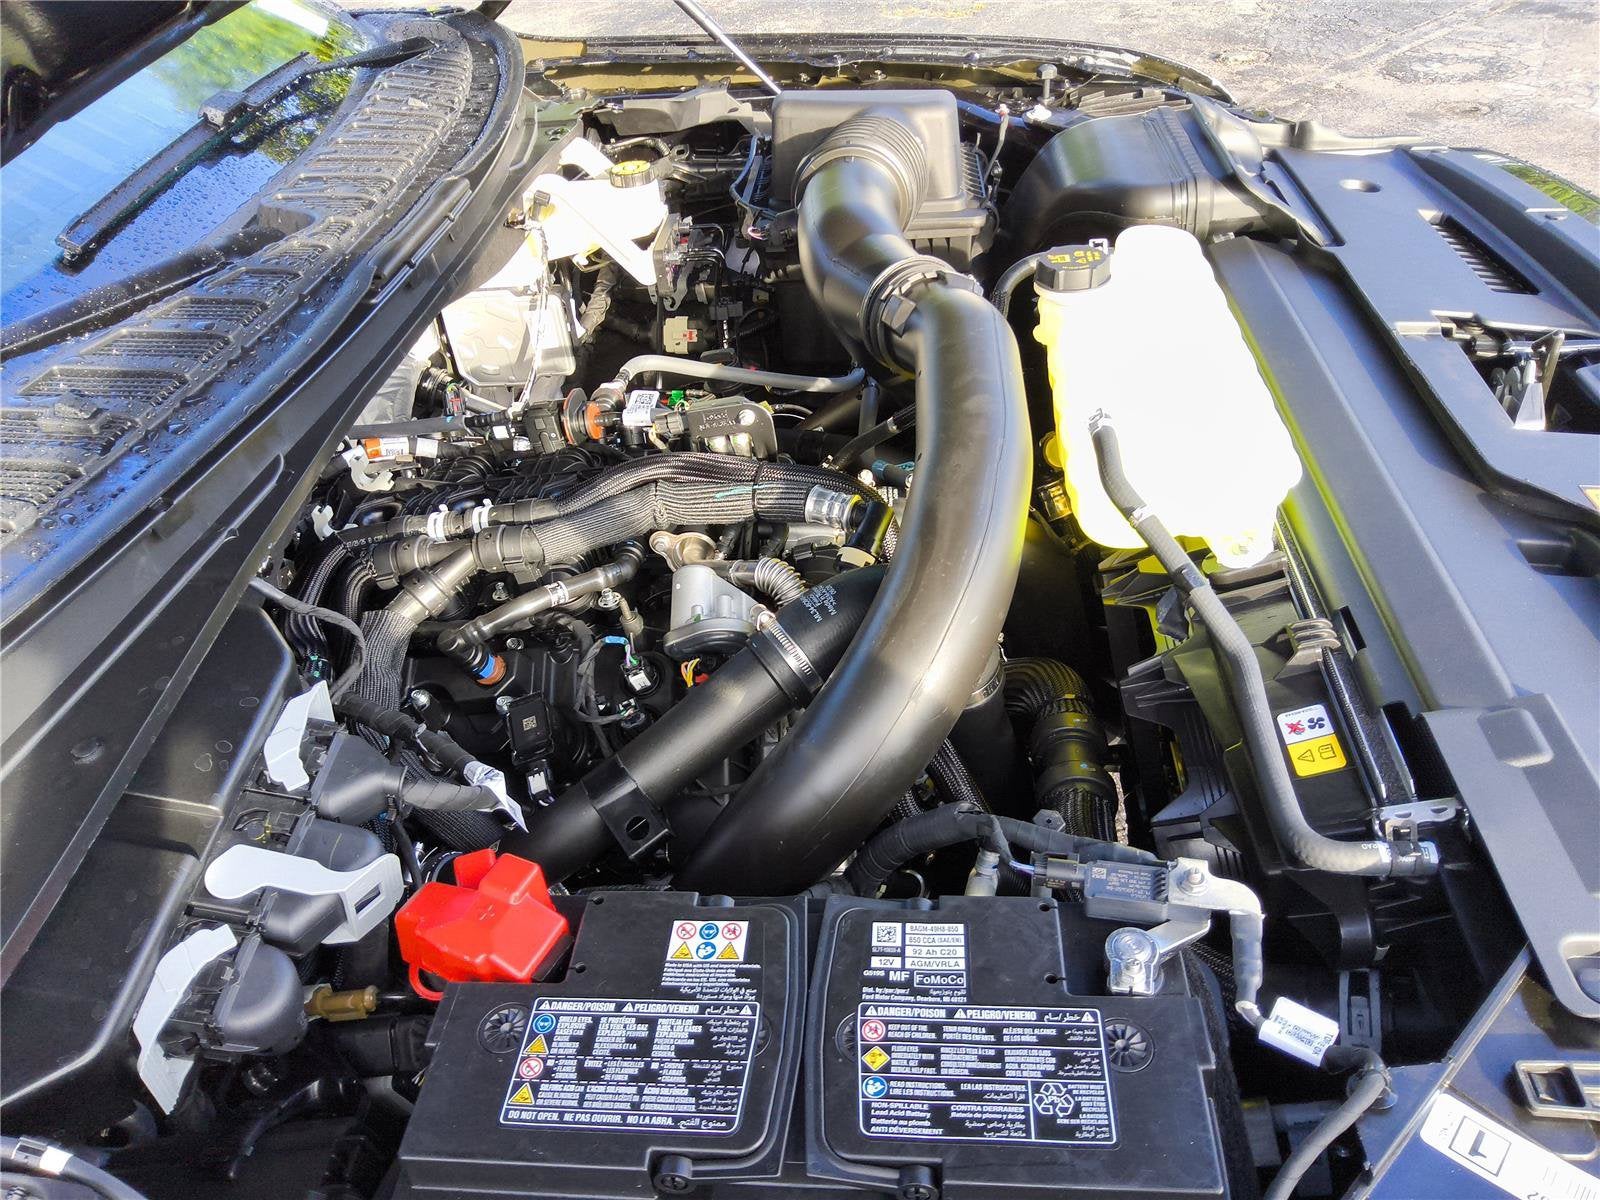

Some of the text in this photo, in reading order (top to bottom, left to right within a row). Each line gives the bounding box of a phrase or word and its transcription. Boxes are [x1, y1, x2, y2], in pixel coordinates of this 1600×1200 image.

[889, 971, 910, 981] MF
[916, 975, 964, 984] FoMoCo
[550, 1002, 616, 1011] DANGER/POISON
[634, 1004, 699, 1013] PELIGRO/VENENO
[878, 1008, 946, 1018] DANGER/POISON
[967, 1010, 1037, 1020] PELIGRO/VENENO
[537, 1112, 561, 1120] OPEN.
[591, 1114, 624, 1123] OUVRIR.
[650, 1117, 676, 1125] ABRA.
